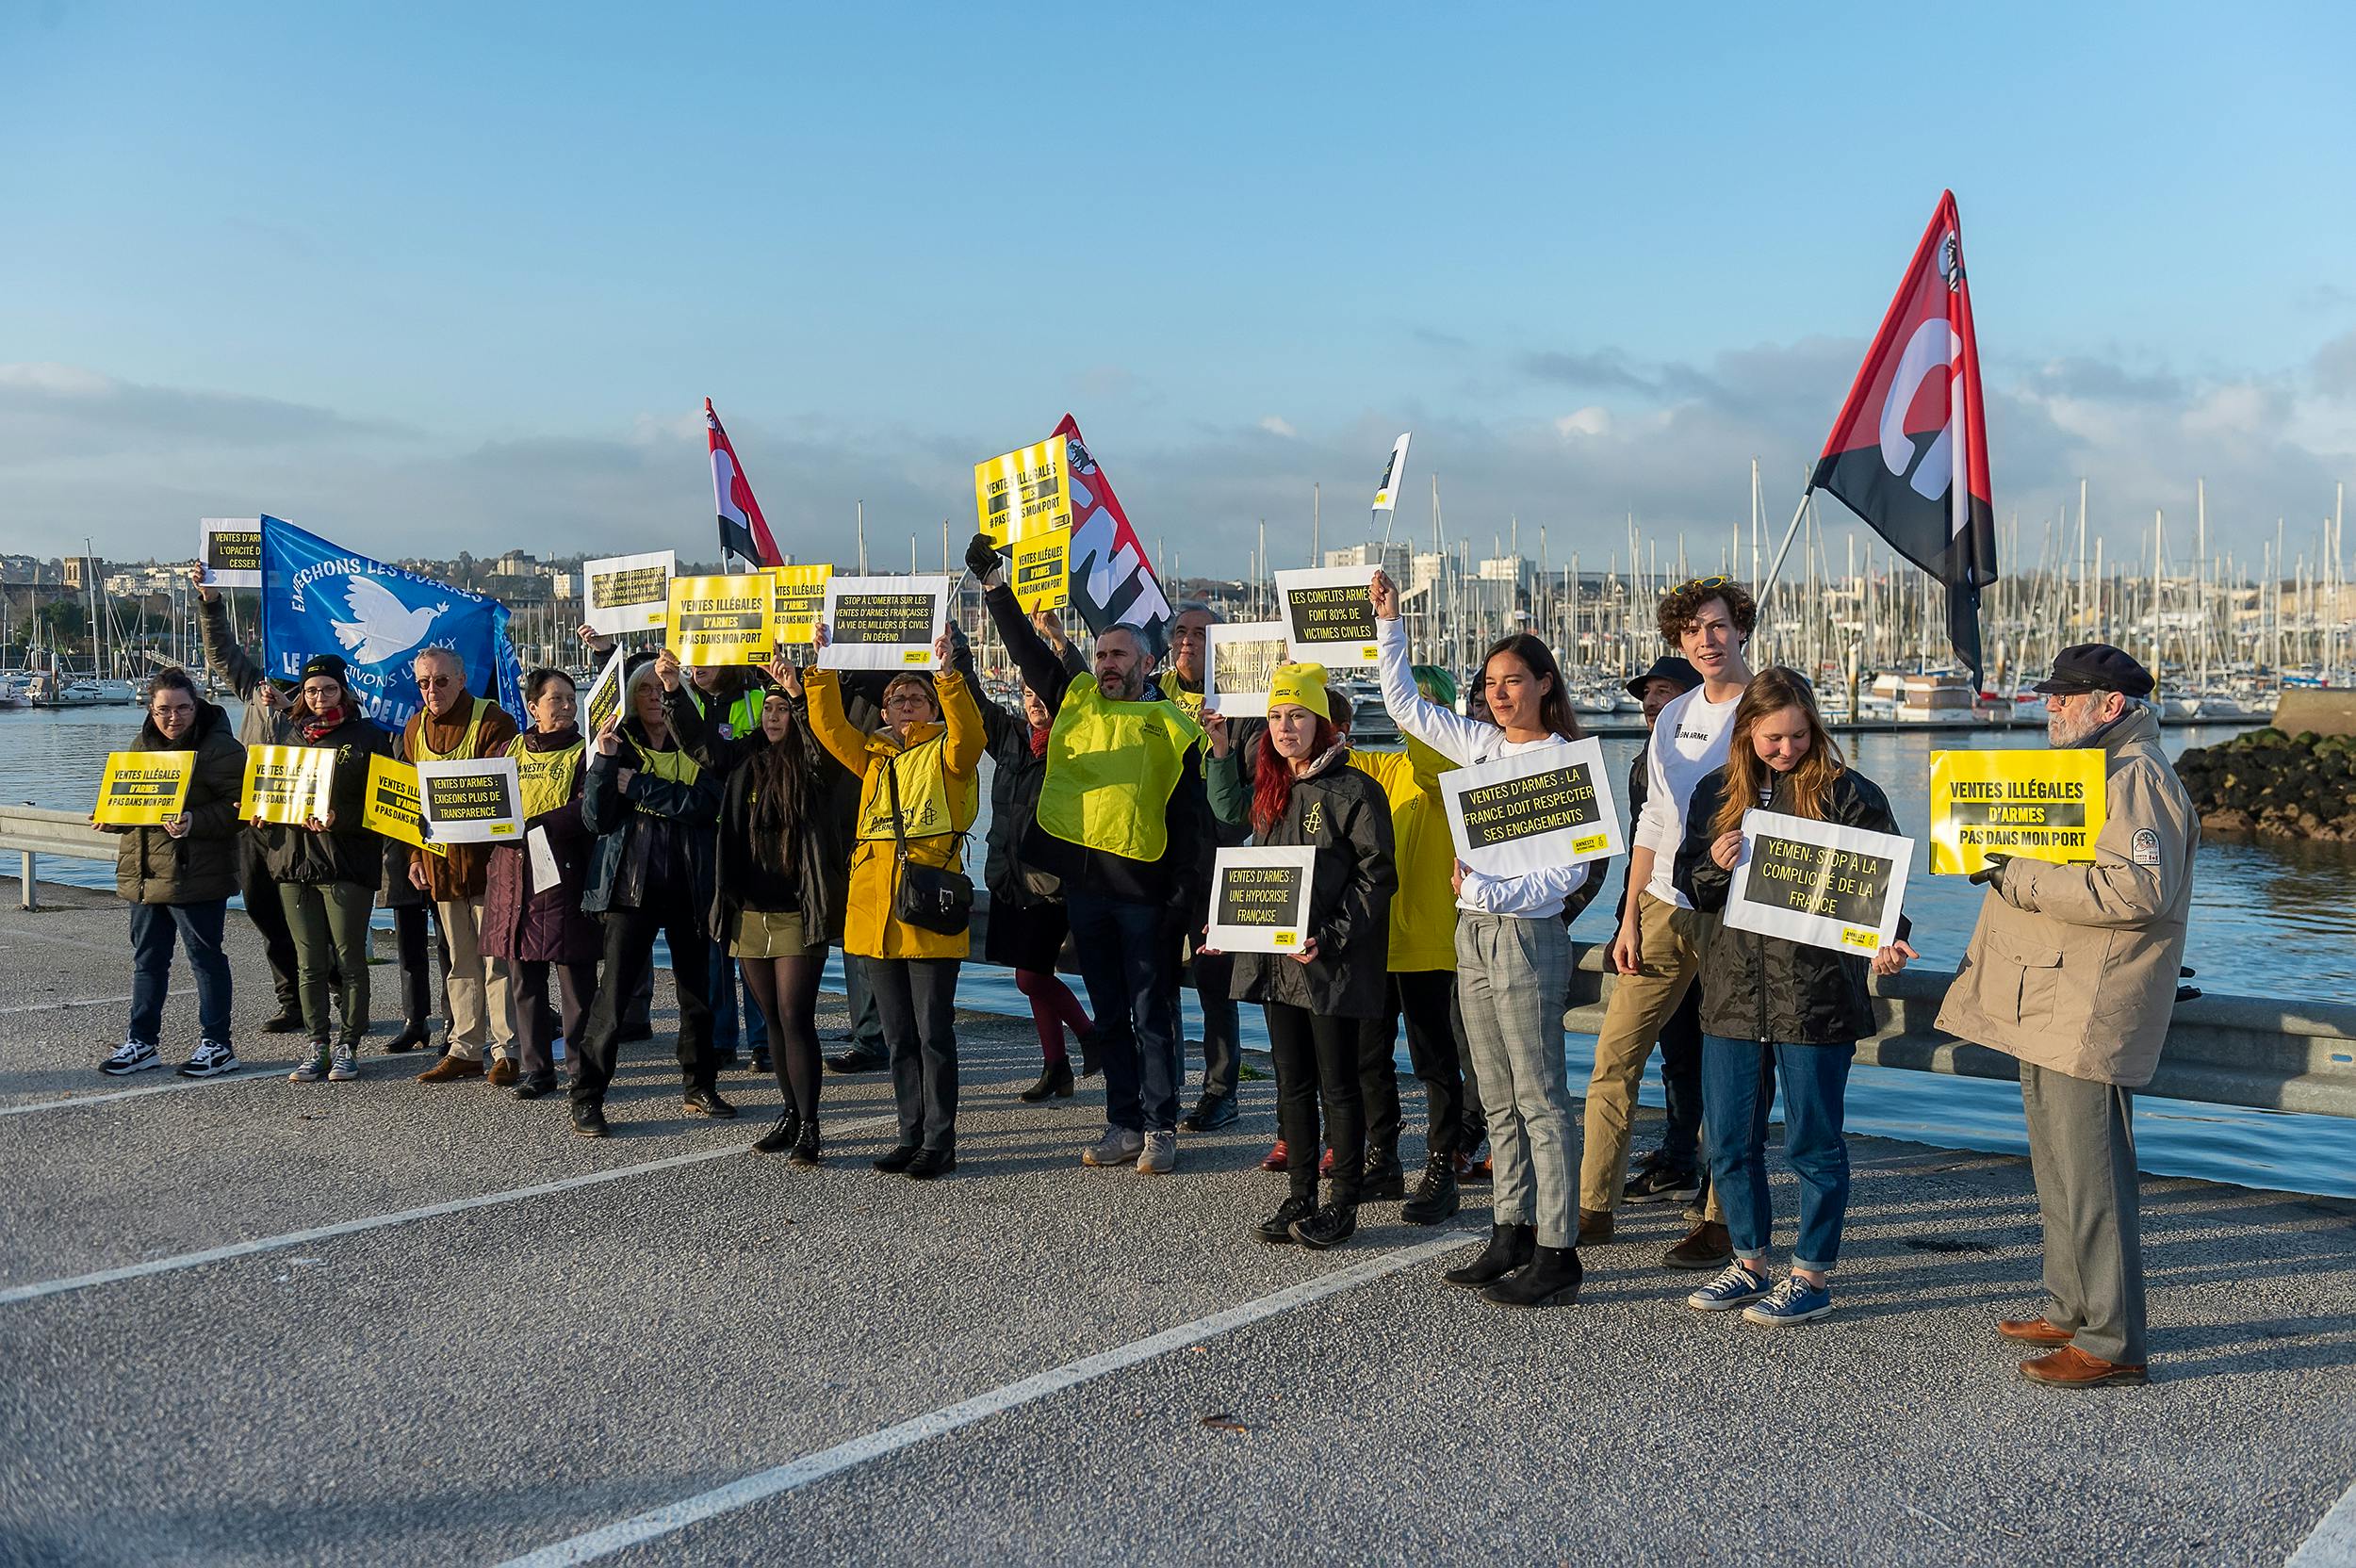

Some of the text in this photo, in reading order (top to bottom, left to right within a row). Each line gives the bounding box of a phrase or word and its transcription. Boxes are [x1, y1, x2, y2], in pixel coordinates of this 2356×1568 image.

[1026, 504, 1041, 516] MON
[1042, 497, 1060, 512] PORT
[215, 533, 261, 543] VENTES D'AR
[220, 546, 254, 555] L'OPACITÉ
[229, 559, 256, 568] CESSER
[368, 561, 398, 577] LES
[776, 582, 825, 596] NTES ILLÉGALES
[681, 596, 762, 612] VENTES ILLÉGALES
[844, 595, 927, 605] STOP À L'OMERTA SUR LES
[1290, 592, 1306, 604] LES
[1307, 590, 1345, 604] CONFLITS
[783, 600, 809, 611] D'ARMES
[782, 615, 796, 624] DANS
[796, 614, 810, 624] MON
[810, 614, 824, 624] PRT
[835, 609, 859, 617] VENTES
[859, 609, 890, 617] D'ARMES
[890, 608, 929, 619] FRANÇAISES
[1308, 608, 1361, 622] FONT 80% DE
[703, 617, 739, 628] D'ARMES
[837, 621, 929, 629] LA VIE DE MILLIERS DE CIVILS
[700, 634, 721, 645] DANS
[722, 633, 741, 644] MON
[740, 632, 761, 644] PORT
[863, 631, 901, 643] EN DÉPEND.
[1303, 626, 1372, 640] VICTIMES CIVILES
[1264, 642, 1286, 654] VENT
[283, 651, 301, 676] LE
[345, 663, 398, 689] TIVONS
[369, 698, 389, 724] DE
[1689, 732, 1709, 742] ARME
[115, 768, 181, 780] VENTES ILLÉGALES
[129, 784, 159, 793] D'ARMES
[379, 775, 406, 793] VENTES
[433, 777, 459, 790] VENTES
[460, 776, 494, 789] D'ARMES
[1469, 786, 1509, 806] VENTES
[1512, 775, 1558, 795] D'ARMES
[1565, 768, 1581, 783] LA
[1950, 778, 2084, 799] VENTES ILLÉGALES
[124, 798, 142, 807] DANS
[142, 798, 157, 807] MON
[156, 798, 176, 807] PORT
[270, 794, 287, 805] DANS
[396, 796, 422, 812] D'ARME
[434, 791, 501, 805] EXIGEONS PLUS DE
[440, 806, 498, 819] TRANSPARENCE
[1464, 785, 1595, 826] FRANCE DOIT RESPECTER
[393, 810, 410, 824] DANS
[410, 815, 420, 827] MO
[1988, 807, 2046, 824] D'ARMES
[1483, 808, 1584, 842] SES ENGAGEMENTS
[1959, 830, 2086, 847] PAS DANS MON PORT
[1768, 839, 1878, 875] YÉMEN: STOP À LA
[1229, 870, 1255, 883] VENTES
[1256, 870, 1290, 883] D'ARMES
[1762, 862, 1873, 898] COMPLICITÉ DE LA
[1229, 890, 1289, 903] UNE HYPOCRISIE
[1789, 890, 1838, 914] FRANCE
[1236, 909, 1277, 924] FRANÇAISE
